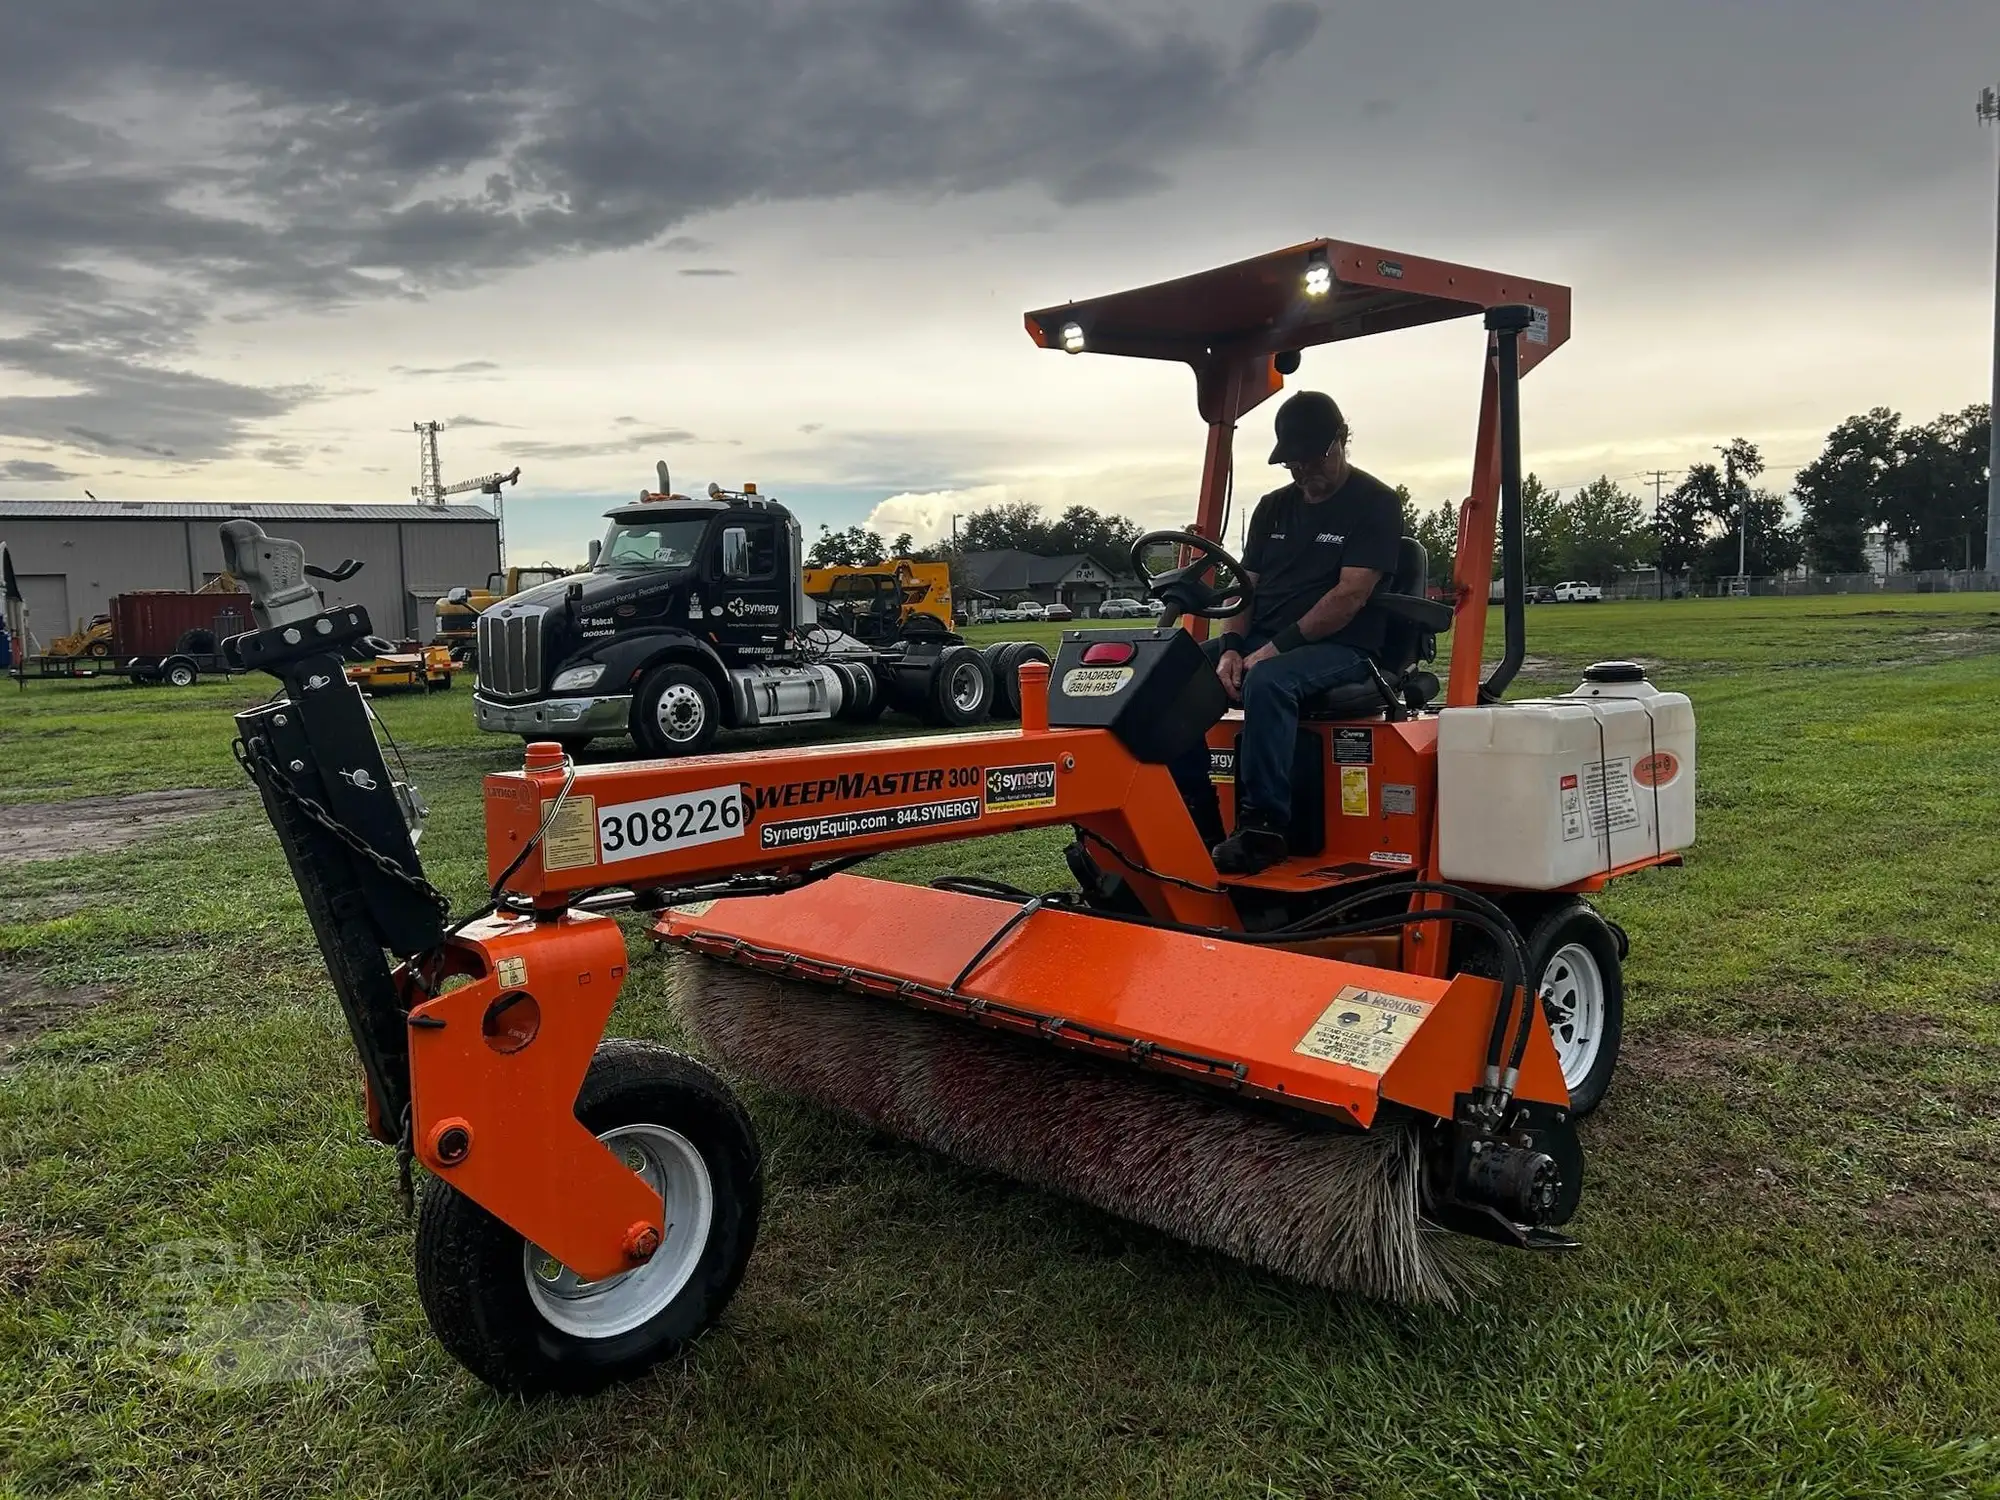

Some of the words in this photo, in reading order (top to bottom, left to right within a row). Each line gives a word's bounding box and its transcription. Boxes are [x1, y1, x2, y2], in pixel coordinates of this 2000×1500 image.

[744, 604, 779, 615] synergy
[591, 617, 614, 626] Bobcat
[582, 629, 616, 638] DOOSAN
[948, 766, 980, 788] 300
[1003, 769, 1055, 791] synergy
[601, 795, 740, 852] 308226
[763, 814, 887, 846] SynergyEquip.com
[897, 800, 979, 825] 844.SYNERGY
[1372, 996, 1422, 1015] WARNING
